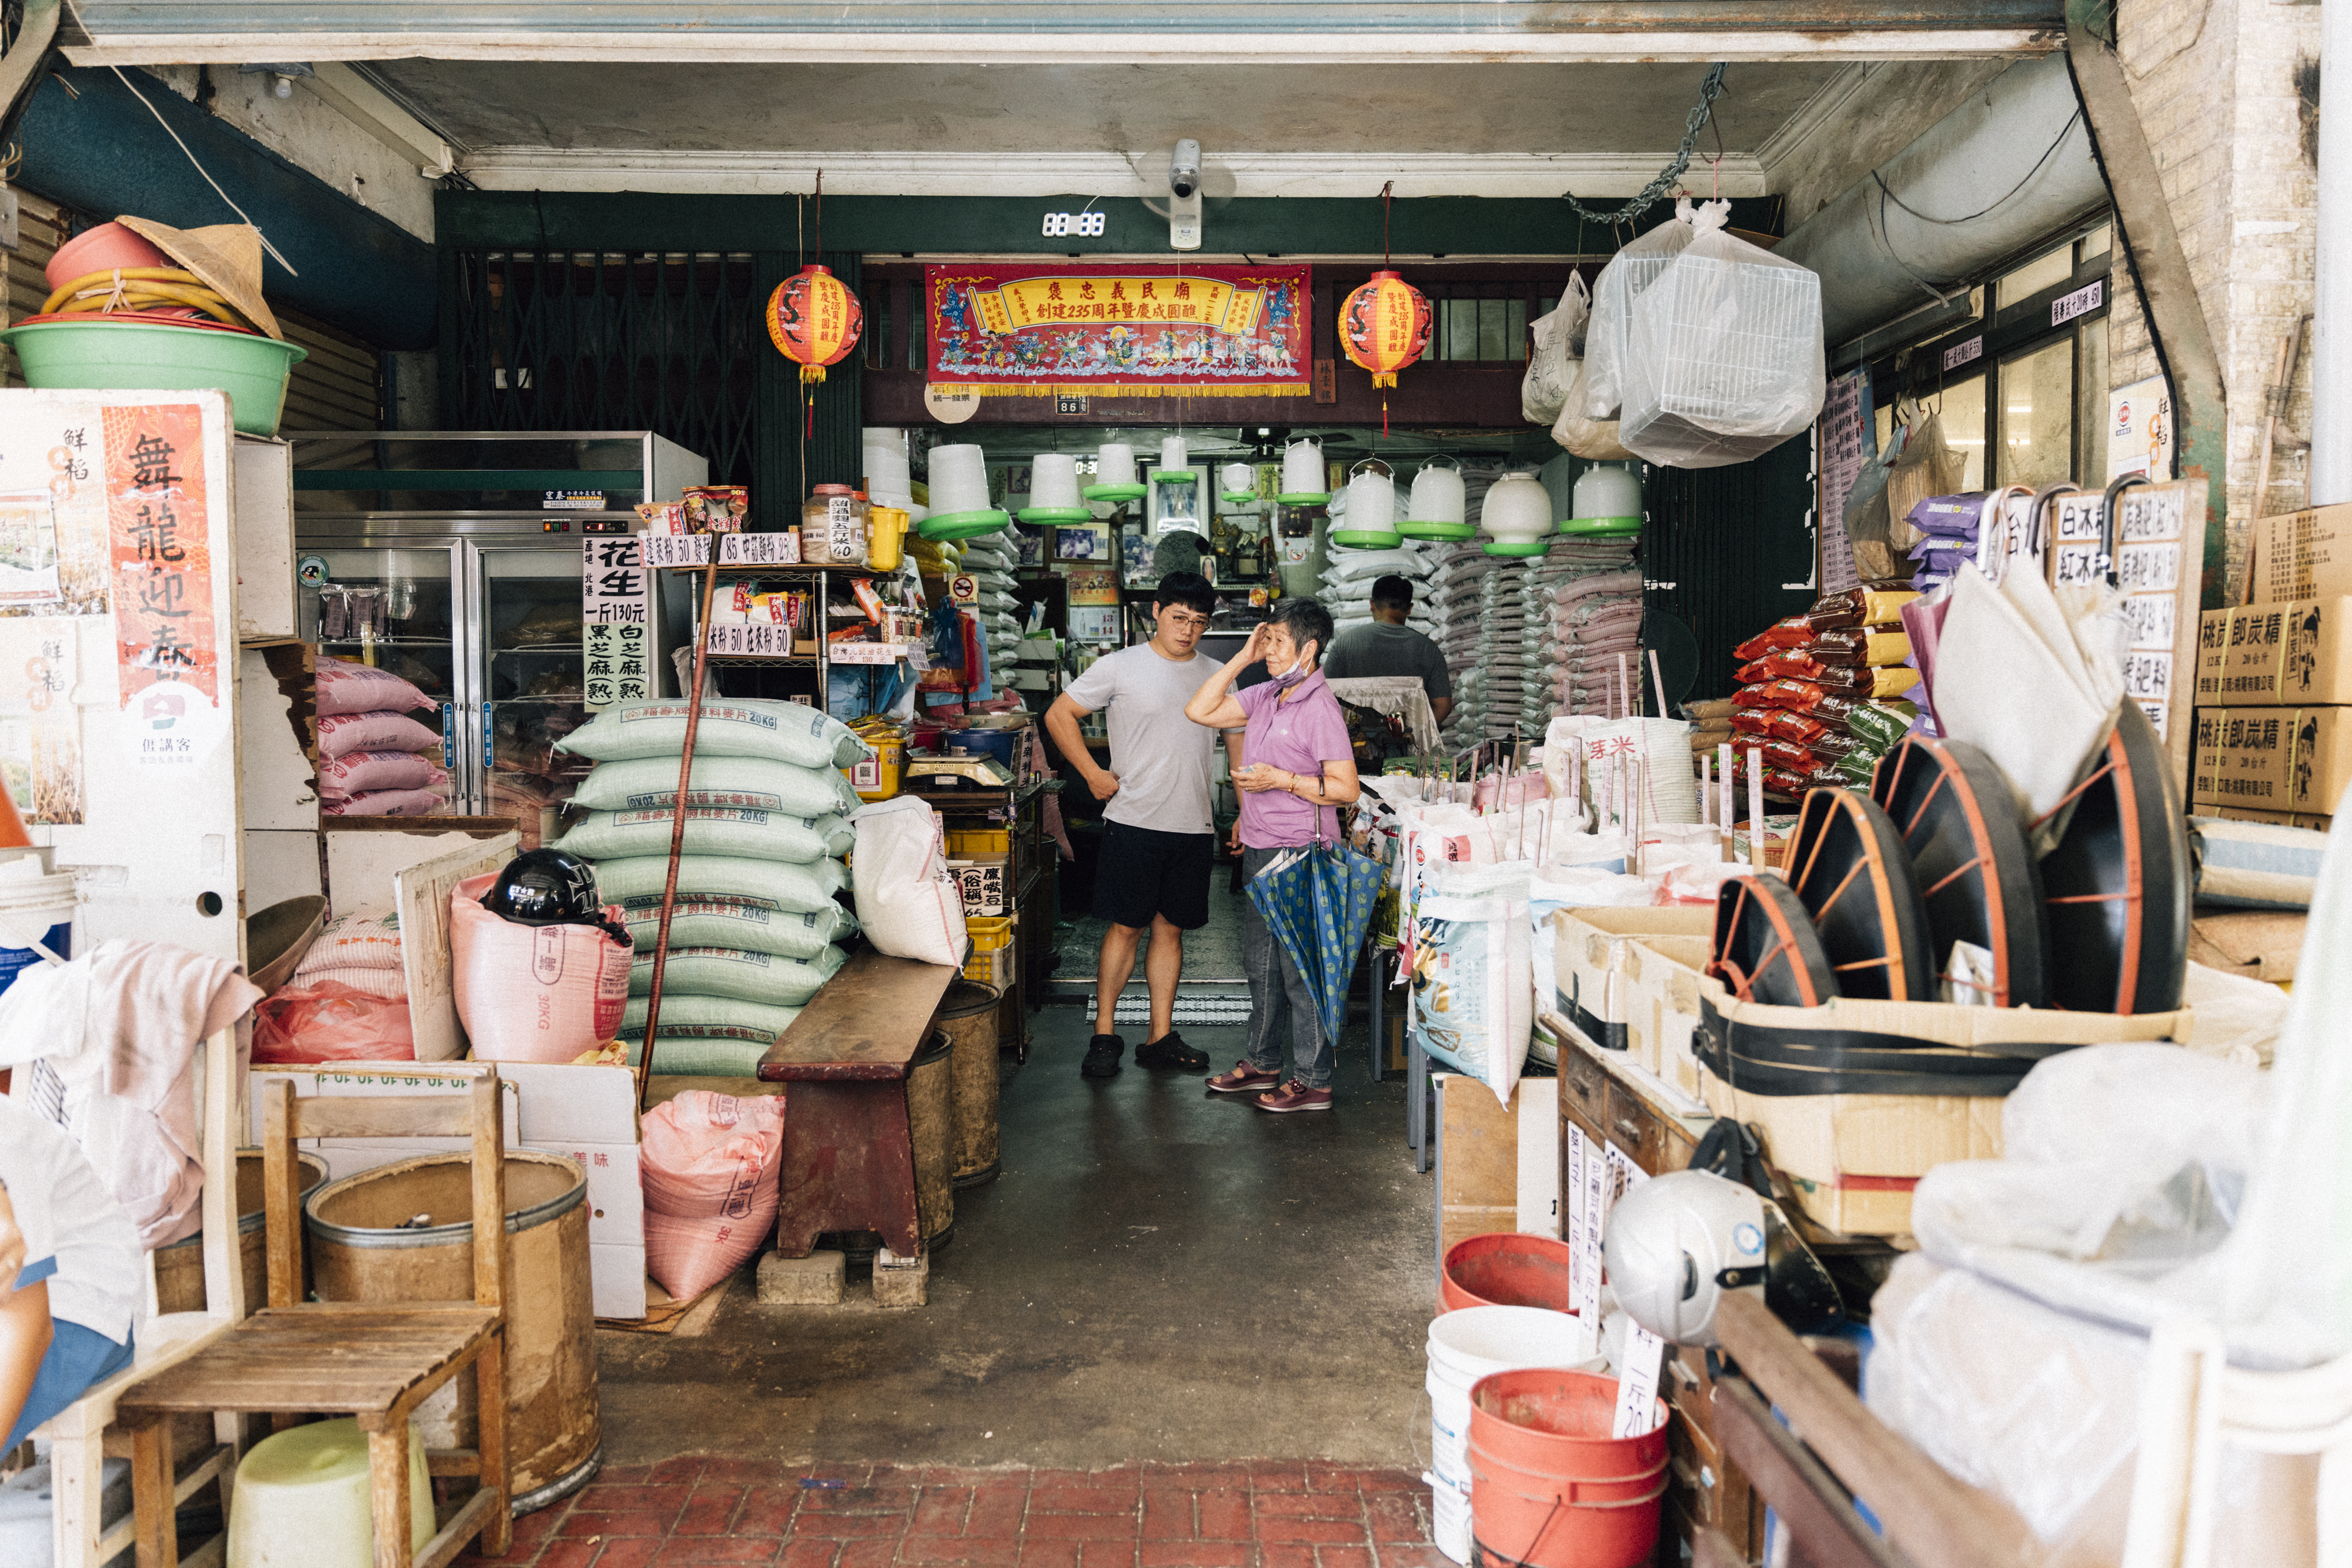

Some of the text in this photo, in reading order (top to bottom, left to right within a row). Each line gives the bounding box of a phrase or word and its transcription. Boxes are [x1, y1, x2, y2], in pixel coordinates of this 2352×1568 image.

[1047, 280, 1190, 301] 褒忠義民廟
[983, 297, 997, 330] 吉祥如意
[991, 294, 1007, 326] 合境平安
[1036, 303, 1198, 320] 創建235周年暨慶成圓醮
[1204, 286, 1220, 323] 民國一一二年
[1237, 298, 1250, 329] 風調雨順
[933, 394, 970, 402] 統一發票
[1061, 402, 1077, 412] 86
[63, 427, 89, 481] 鮮稻
[128, 434, 198, 681] 舞龍迎春
[678, 539, 689, 562] 50
[726, 537, 737, 560] 85
[585, 540, 593, 597] 產地 北港
[598, 540, 644, 597] 花生
[585, 602, 645, 623] 一斤130元
[1103, 614, 1113, 623] 13
[731, 628, 741, 651] 50
[777, 628, 787, 652] 50
[1103, 626, 1113, 634] 14
[41, 638, 65, 692] 鮮稻
[750, 712, 774, 727] 20KG
[630, 795, 656, 808] 20KG
[740, 810, 765, 823] 20KG
[983, 867, 1003, 907] 鷹嘴豆
[741, 907, 767, 921] 20KG
[743, 951, 768, 964] 20KG
[1454, 945, 1462, 1001] コシヒカリ
[537, 994, 550, 1030] 30KG
[573, 1152, 609, 1168] 美味
